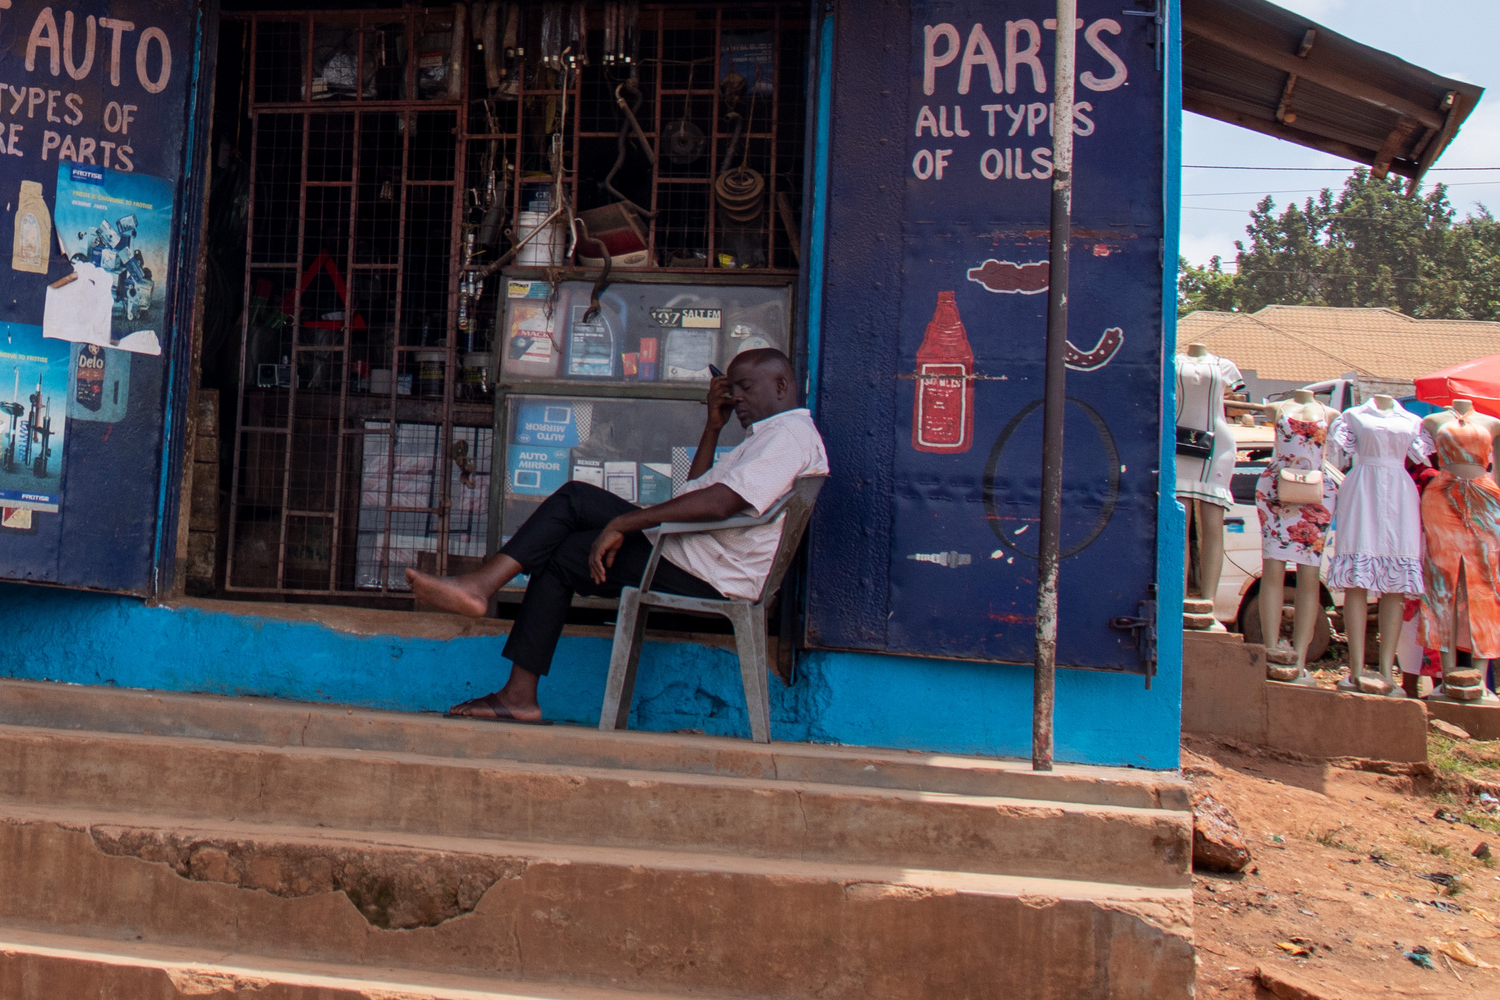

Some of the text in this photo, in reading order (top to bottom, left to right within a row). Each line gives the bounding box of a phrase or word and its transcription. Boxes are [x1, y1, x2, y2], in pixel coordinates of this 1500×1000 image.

[25, 6, 173, 95] AUTO
[103, 101, 138, 135] OF
[914, 104, 971, 138] ALL
[41, 128, 135, 172] PARTS
[912, 147, 1056, 180] OF OILS
[79, 354, 104, 369] Delo
[518, 461, 561, 471] MIRROR
[519, 452, 548, 461] AUTO
